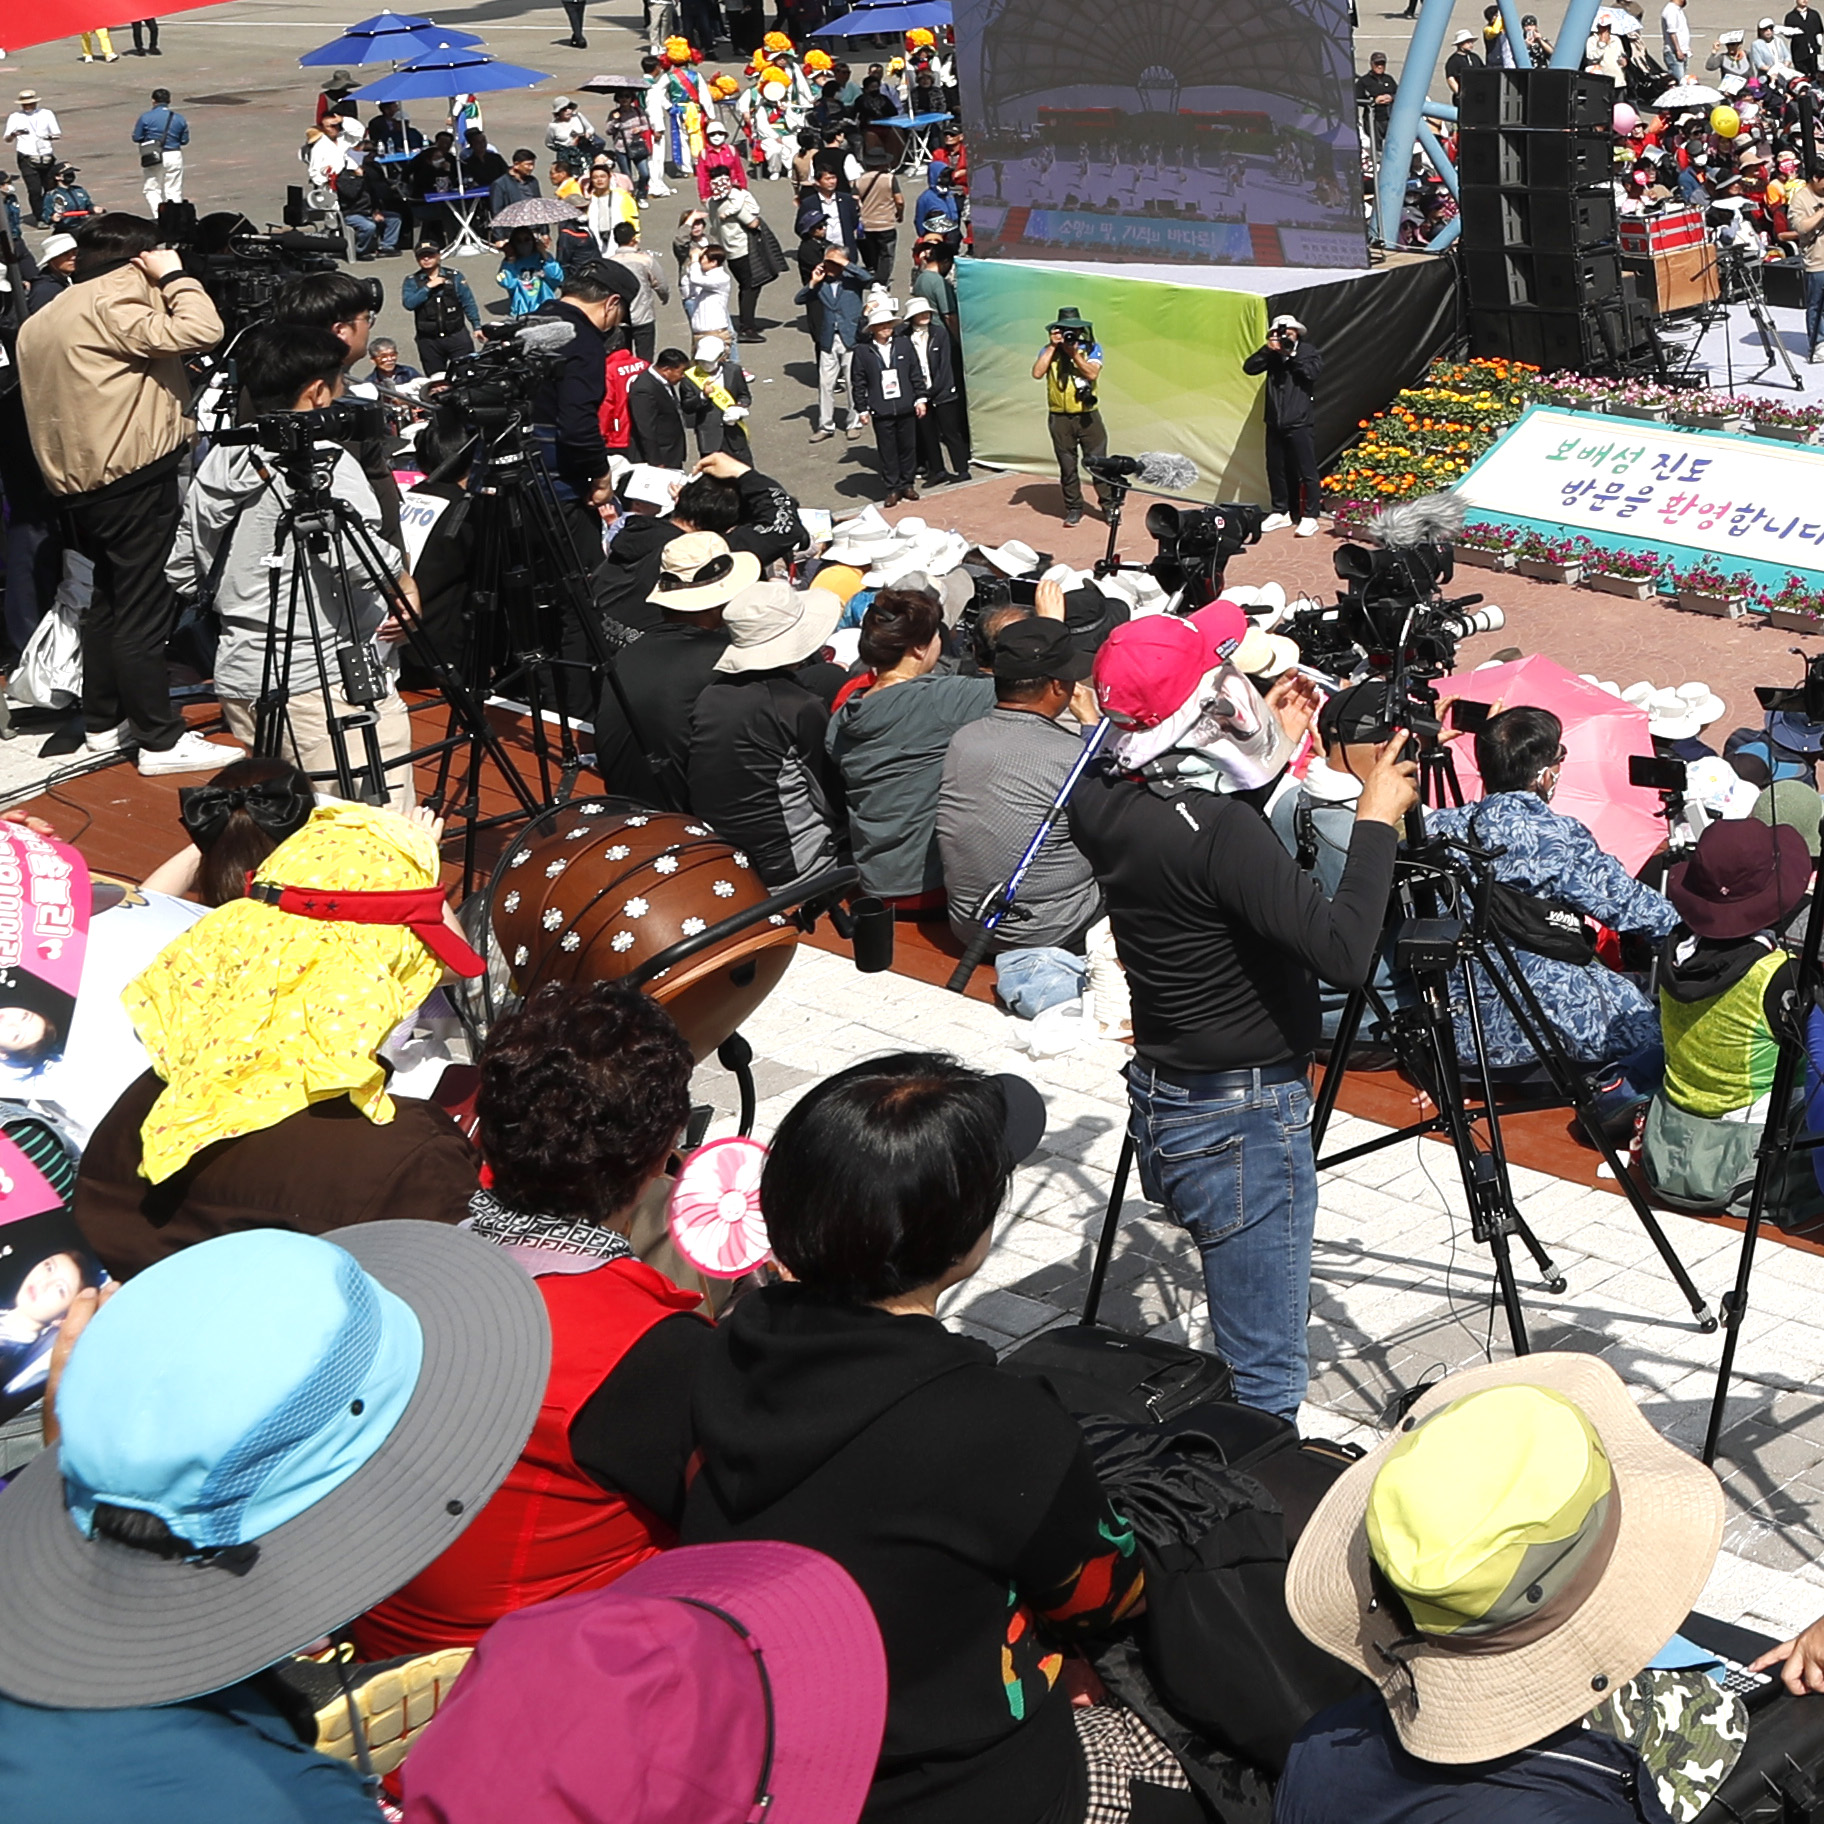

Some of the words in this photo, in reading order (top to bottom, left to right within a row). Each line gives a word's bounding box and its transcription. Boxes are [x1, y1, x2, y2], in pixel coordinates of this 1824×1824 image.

[1545, 438, 1645, 475] 보배섬
[1650, 453, 1713, 483] 진도
[1560, 479, 1653, 517] 방문을
